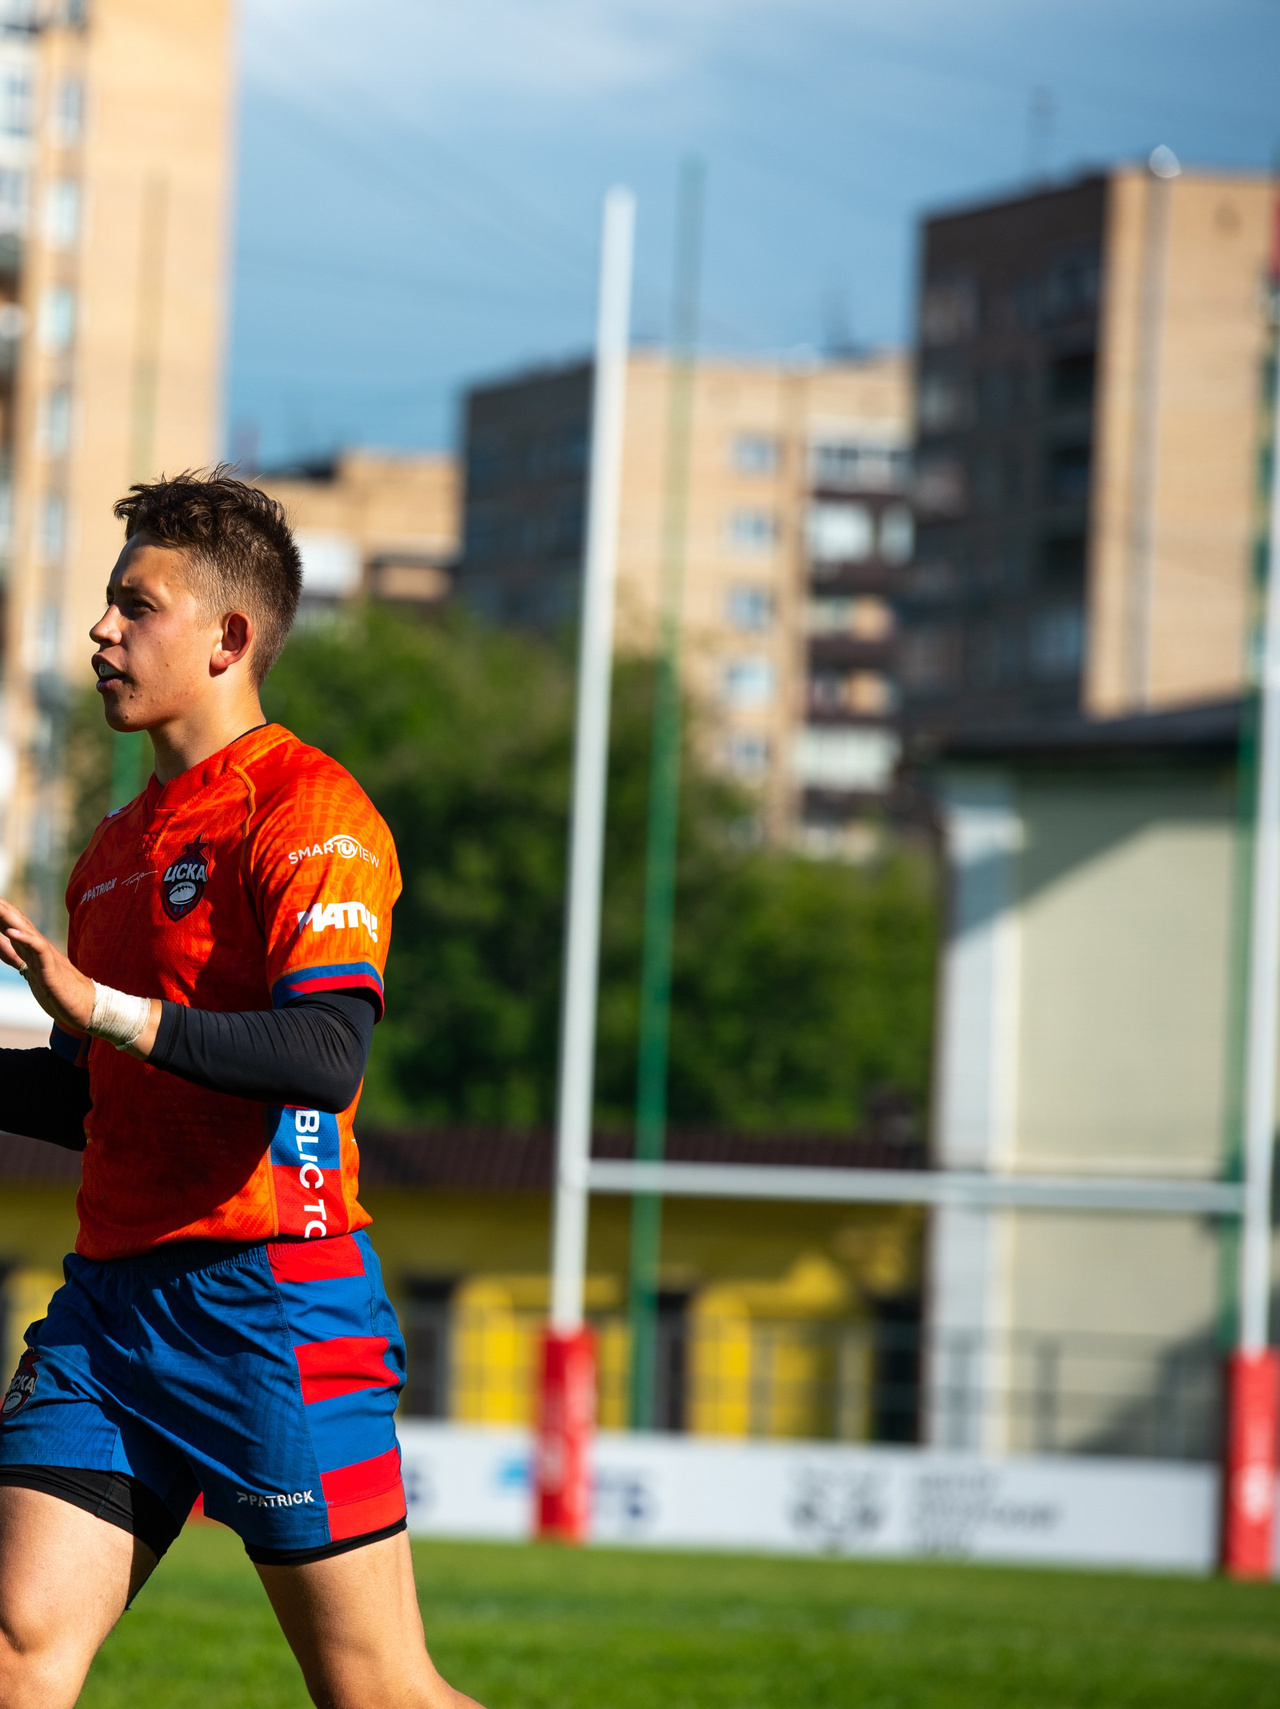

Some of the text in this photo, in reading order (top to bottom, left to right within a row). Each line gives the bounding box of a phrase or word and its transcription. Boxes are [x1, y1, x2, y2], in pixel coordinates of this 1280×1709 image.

[163, 863, 207, 882] ЦСКА
[9, 1375, 35, 1394] СКА
[249, 1490, 315, 1508] PATRICK
